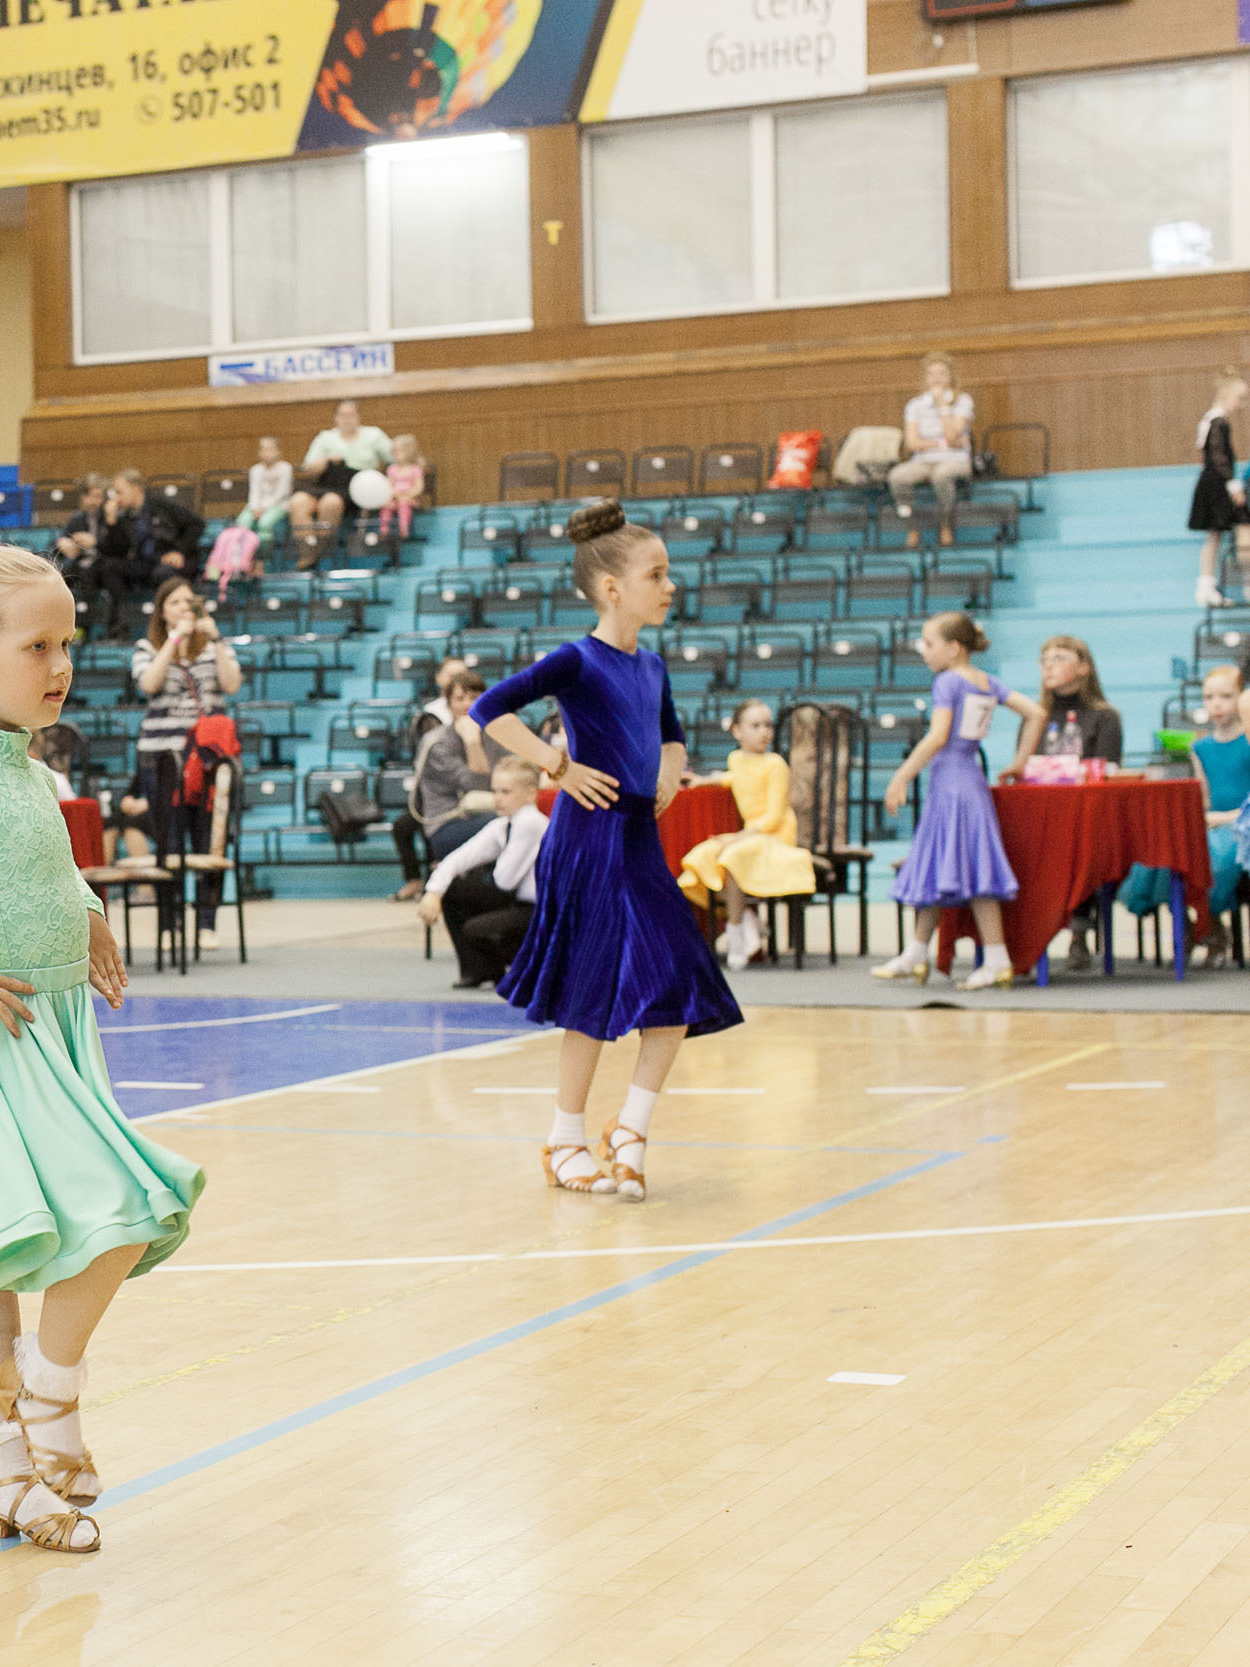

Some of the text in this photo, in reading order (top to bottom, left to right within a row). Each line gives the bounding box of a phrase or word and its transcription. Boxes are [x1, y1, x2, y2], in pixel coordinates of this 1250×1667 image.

[127, 49, 168, 84] 16,
[178, 41, 255, 81] офис
[264, 34, 281, 65] 2
[705, 31, 837, 77] баннер
[171, 81, 282, 123] 507-501
